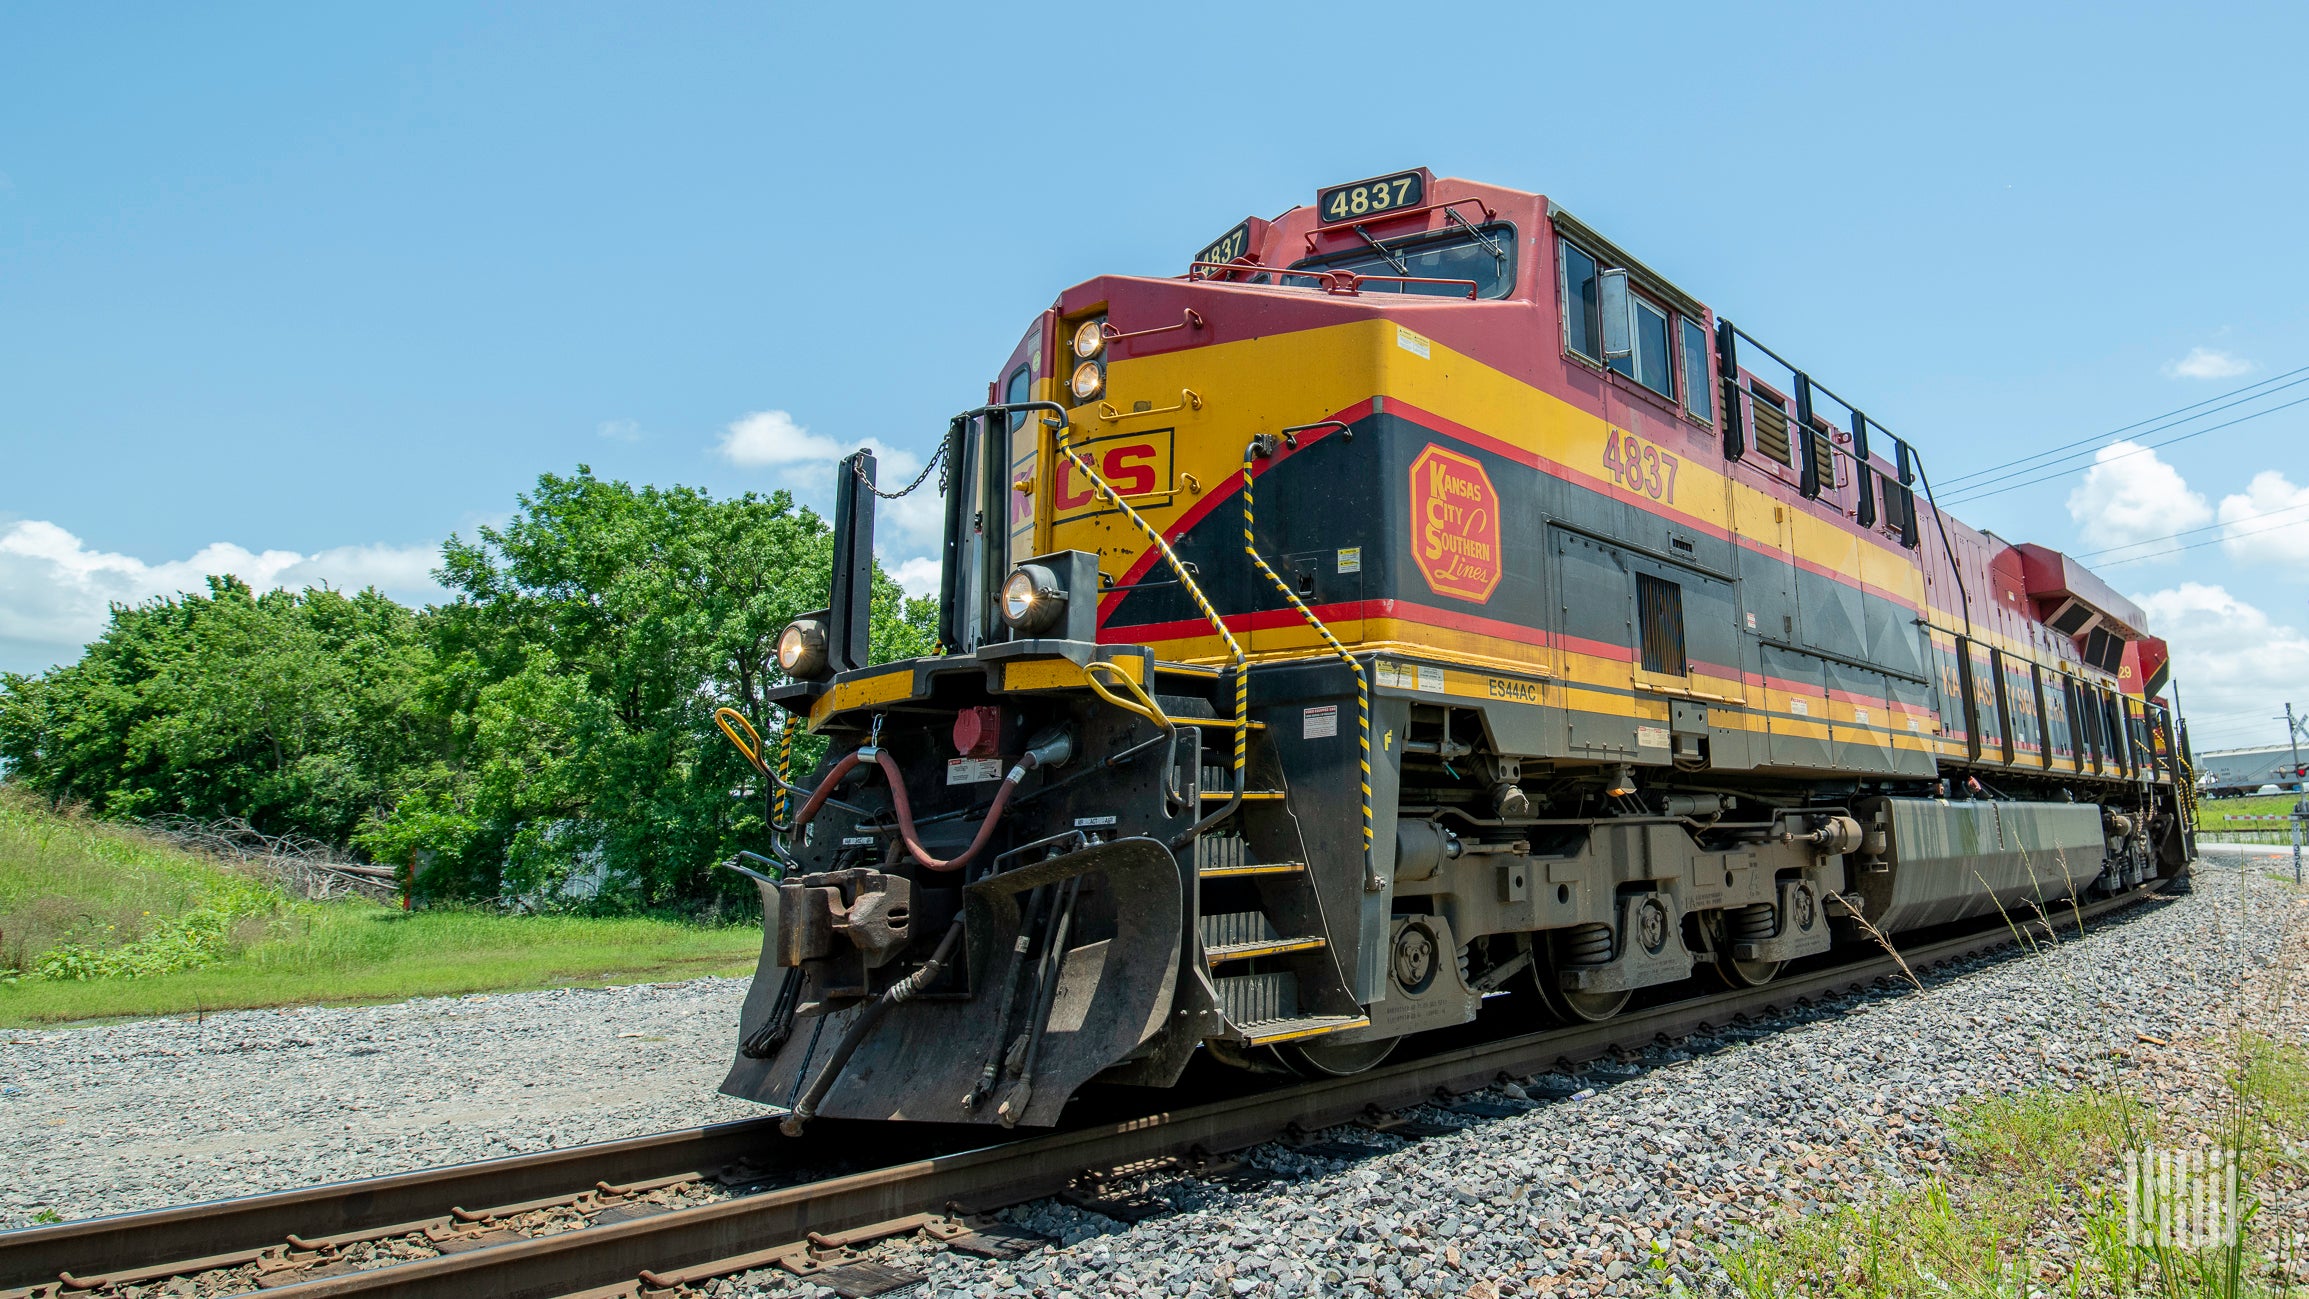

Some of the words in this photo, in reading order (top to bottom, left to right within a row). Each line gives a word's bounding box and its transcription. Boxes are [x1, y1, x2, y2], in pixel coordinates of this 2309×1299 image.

[1330, 177, 1412, 218] 4837
[1201, 229, 1243, 276] 4837
[1429, 459, 1482, 502] KANSAS
[1603, 429, 1678, 505] 4837
[1426, 496, 1464, 530] CITY
[1425, 522, 1491, 562] SOUTHERN
[1434, 553, 1489, 584] Lines
[1489, 678, 1537, 702] ES44AC
[1941, 663, 1993, 707] KAAS
